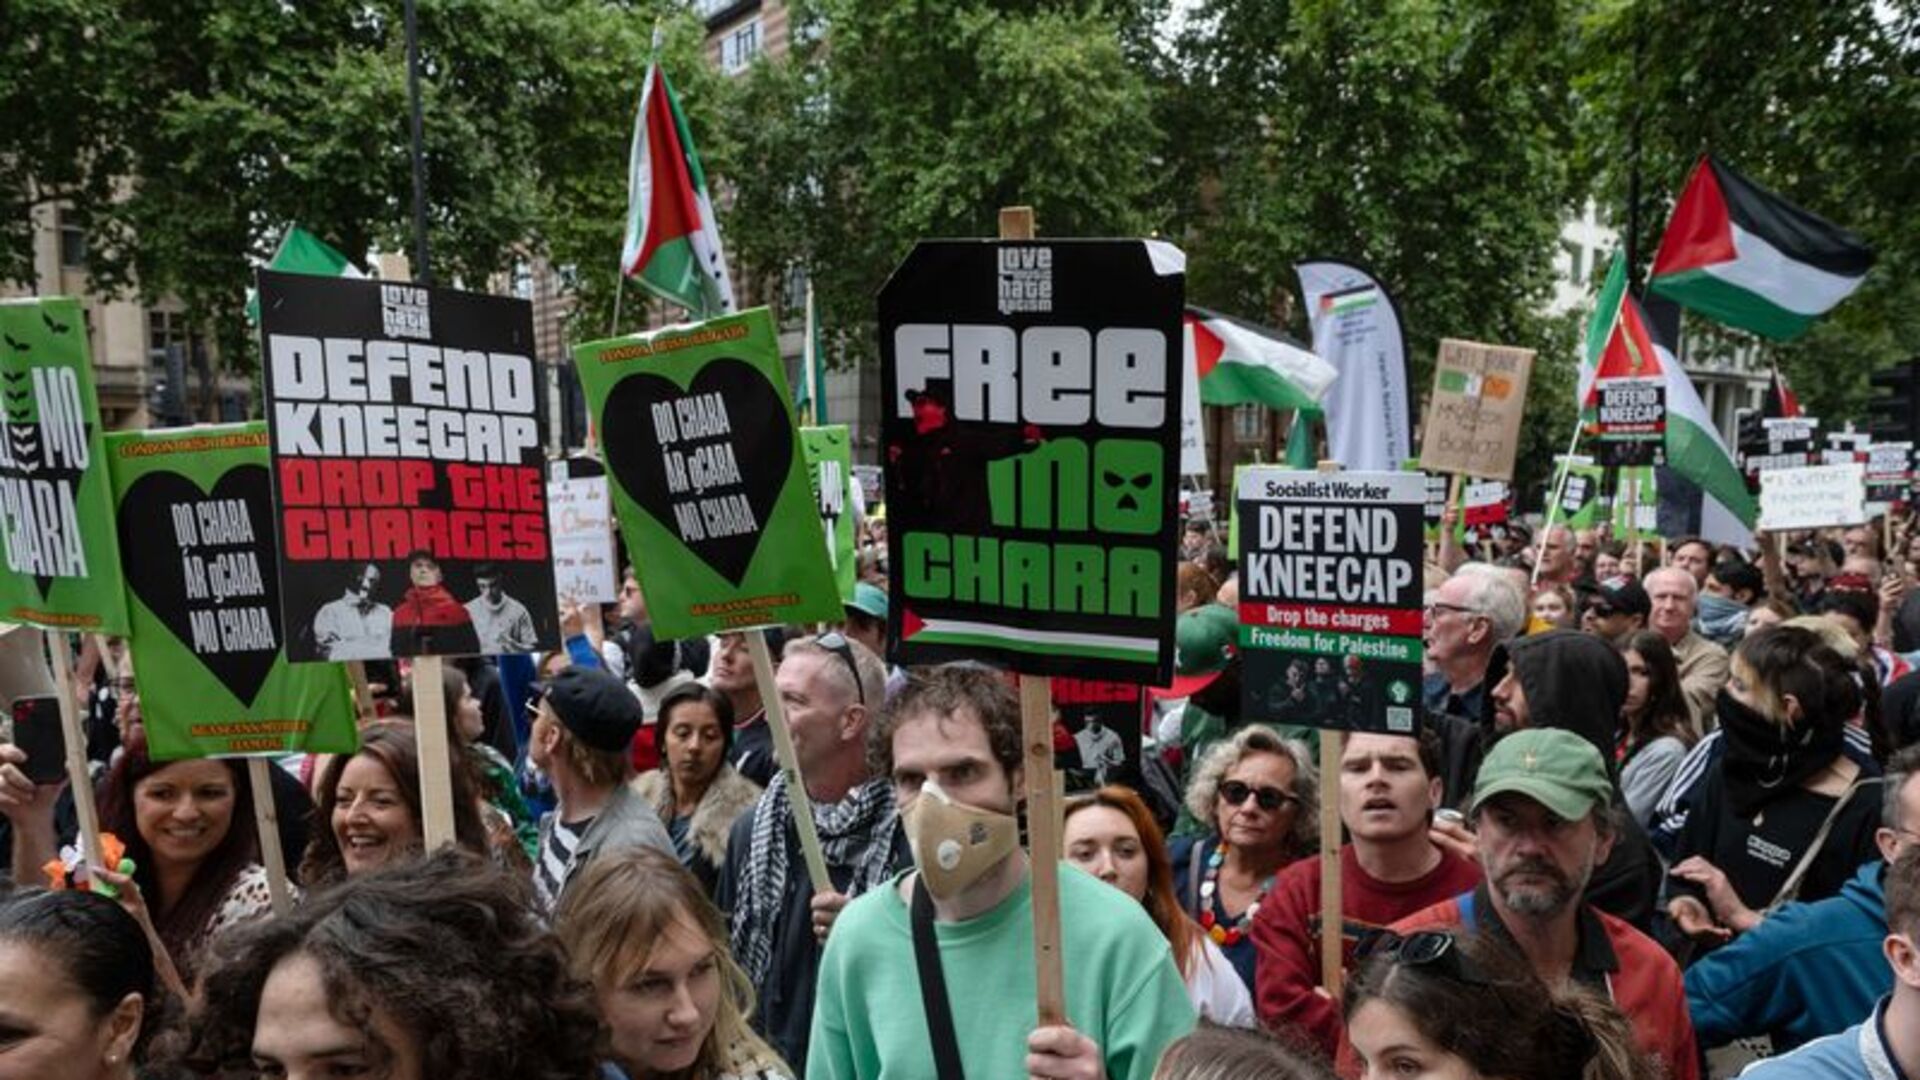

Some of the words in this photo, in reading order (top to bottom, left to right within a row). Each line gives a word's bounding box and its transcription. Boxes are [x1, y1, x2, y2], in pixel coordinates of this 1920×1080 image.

[269, 334, 536, 414] DEFEND
[31, 366, 90, 470] MO
[275, 401, 539, 464] KNEECAP
[674, 391, 731, 440] CHARA
[278, 457, 437, 507] DROP
[1266, 482, 1330, 498] Socialist
[1331, 482, 1390, 500] Worker
[196, 498, 254, 545] CHARA
[284, 507, 547, 561] CHARGES
[700, 493, 759, 538] CHARA
[1259, 505, 1398, 554] DEFEND
[902, 531, 1162, 618] CHARA
[1248, 552, 1413, 604] KNEECAP
[217, 607, 276, 652] CHARA
[1251, 627, 1311, 649] Freedom
[1314, 633, 1335, 651] for
[1339, 635, 1409, 658] Palestine
[1267, 605, 1300, 627] Drop
[1304, 608, 1328, 625] the
[1331, 610, 1390, 631] charges
